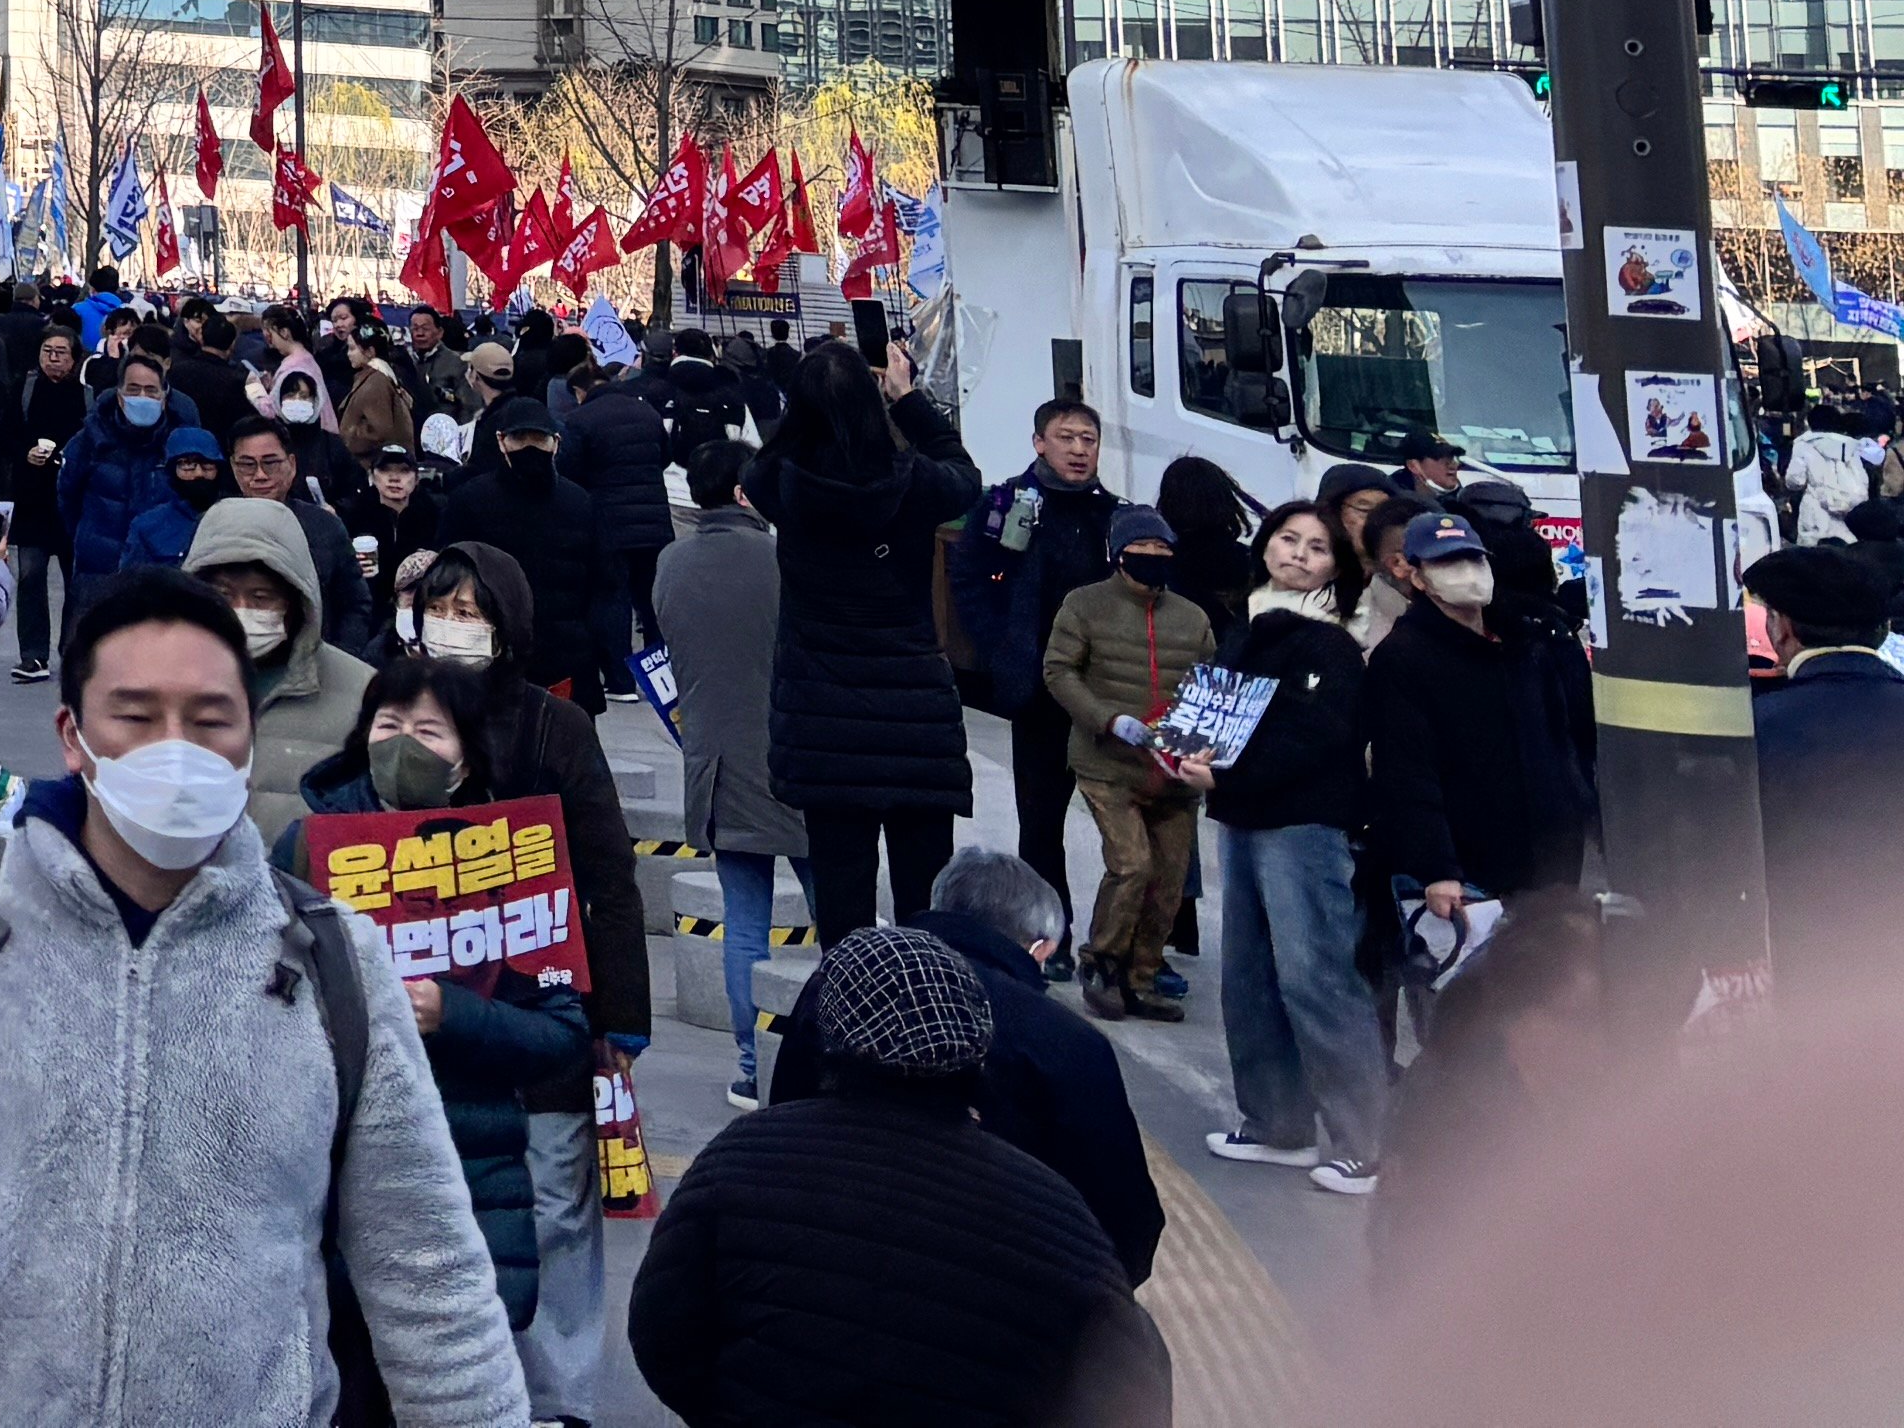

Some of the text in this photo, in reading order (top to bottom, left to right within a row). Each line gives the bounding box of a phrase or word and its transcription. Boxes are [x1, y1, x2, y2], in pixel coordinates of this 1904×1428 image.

[327, 817, 556, 913] 윤석열을
[385, 888, 570, 978] 면하라!
[537, 966, 573, 988] 민주당
